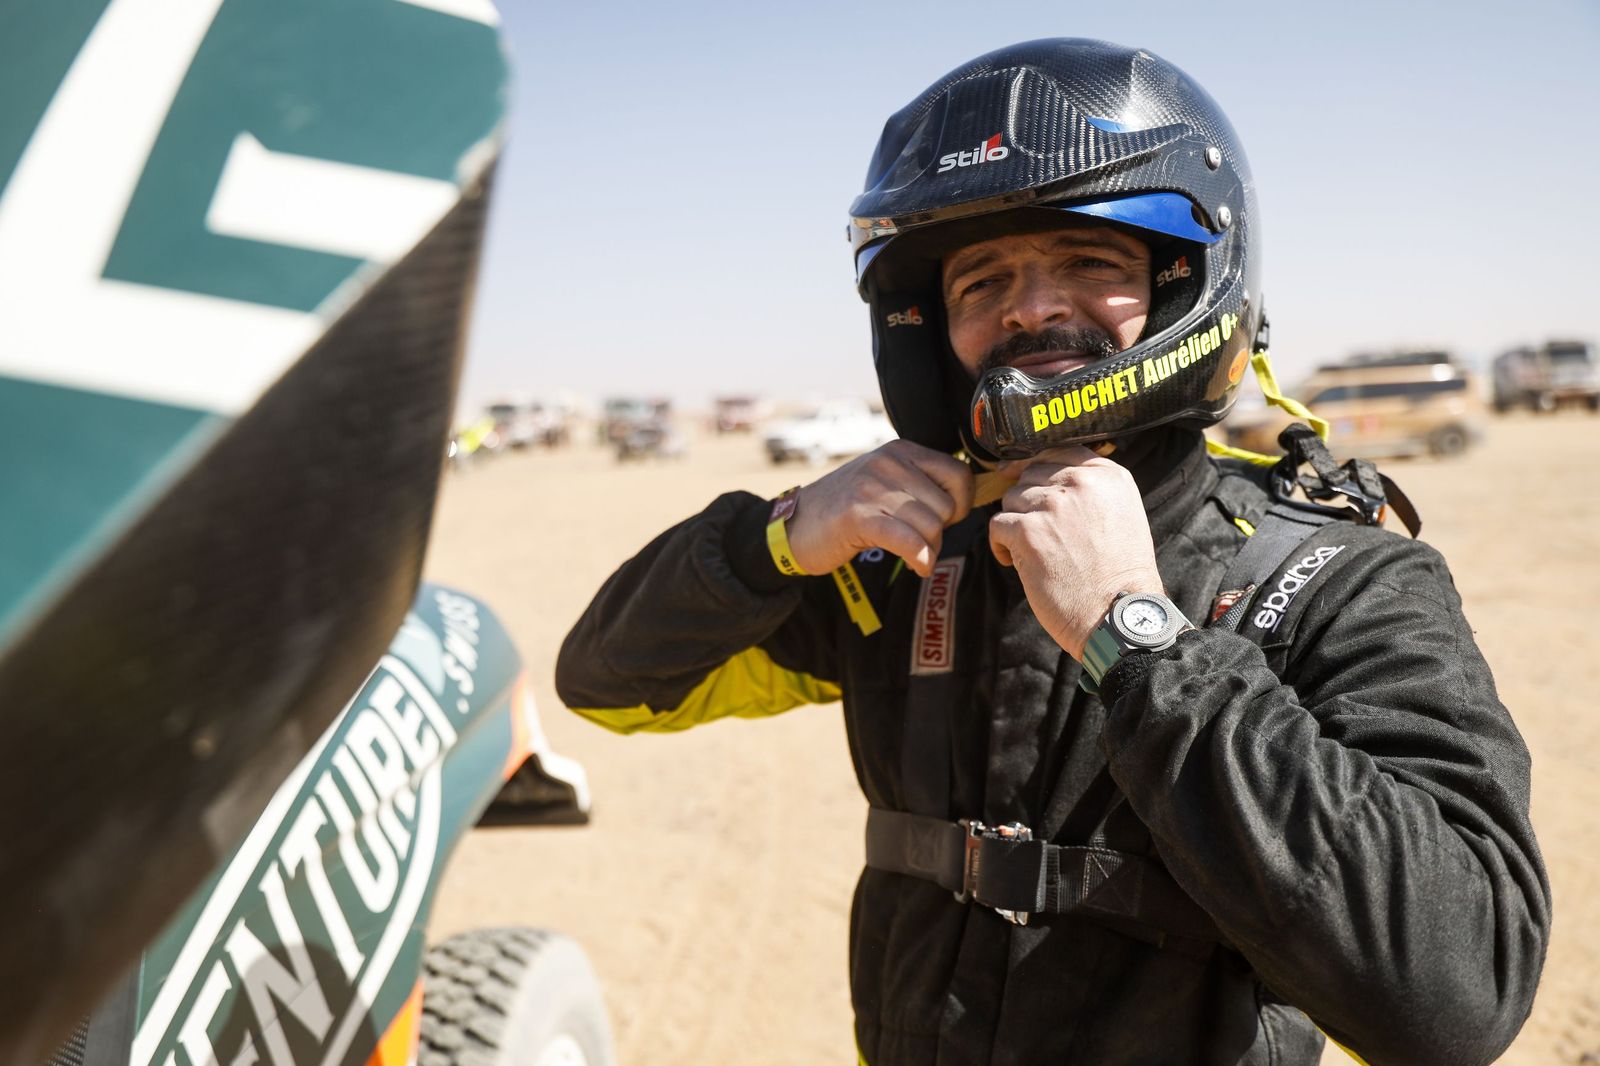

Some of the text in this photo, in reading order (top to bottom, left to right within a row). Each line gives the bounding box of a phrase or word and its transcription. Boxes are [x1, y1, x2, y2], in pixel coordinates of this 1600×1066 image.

[936, 139, 1009, 174] Stilo
[1031, 366, 1138, 432] BOUCHET
[1142, 325, 1220, 388] Aurélien
[922, 571, 951, 662] SIMPSON
[1253, 545, 1345, 631] sparco
